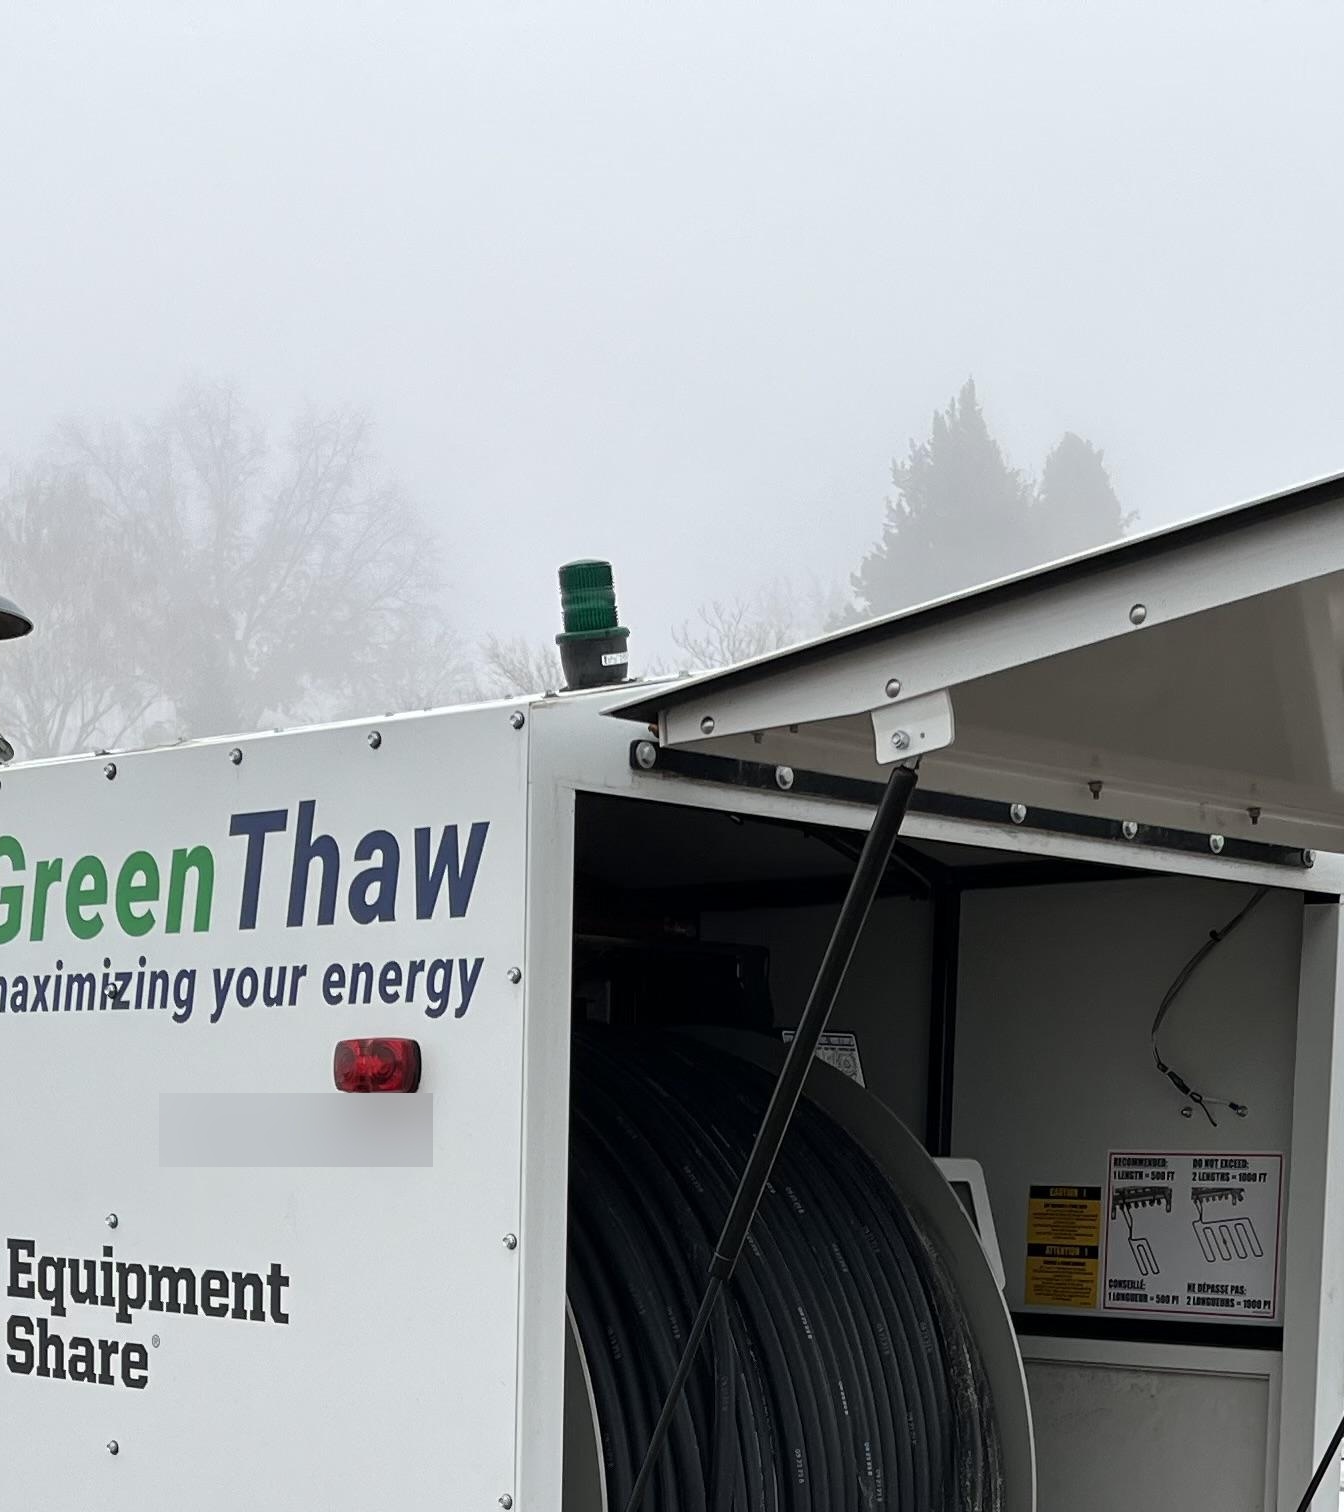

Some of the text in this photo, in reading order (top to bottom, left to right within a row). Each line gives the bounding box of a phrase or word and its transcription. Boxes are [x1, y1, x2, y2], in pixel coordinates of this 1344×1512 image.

[211, 960, 308, 1024] your
[322, 953, 486, 1020] energy
[5, 1238, 290, 1325] Equipment
